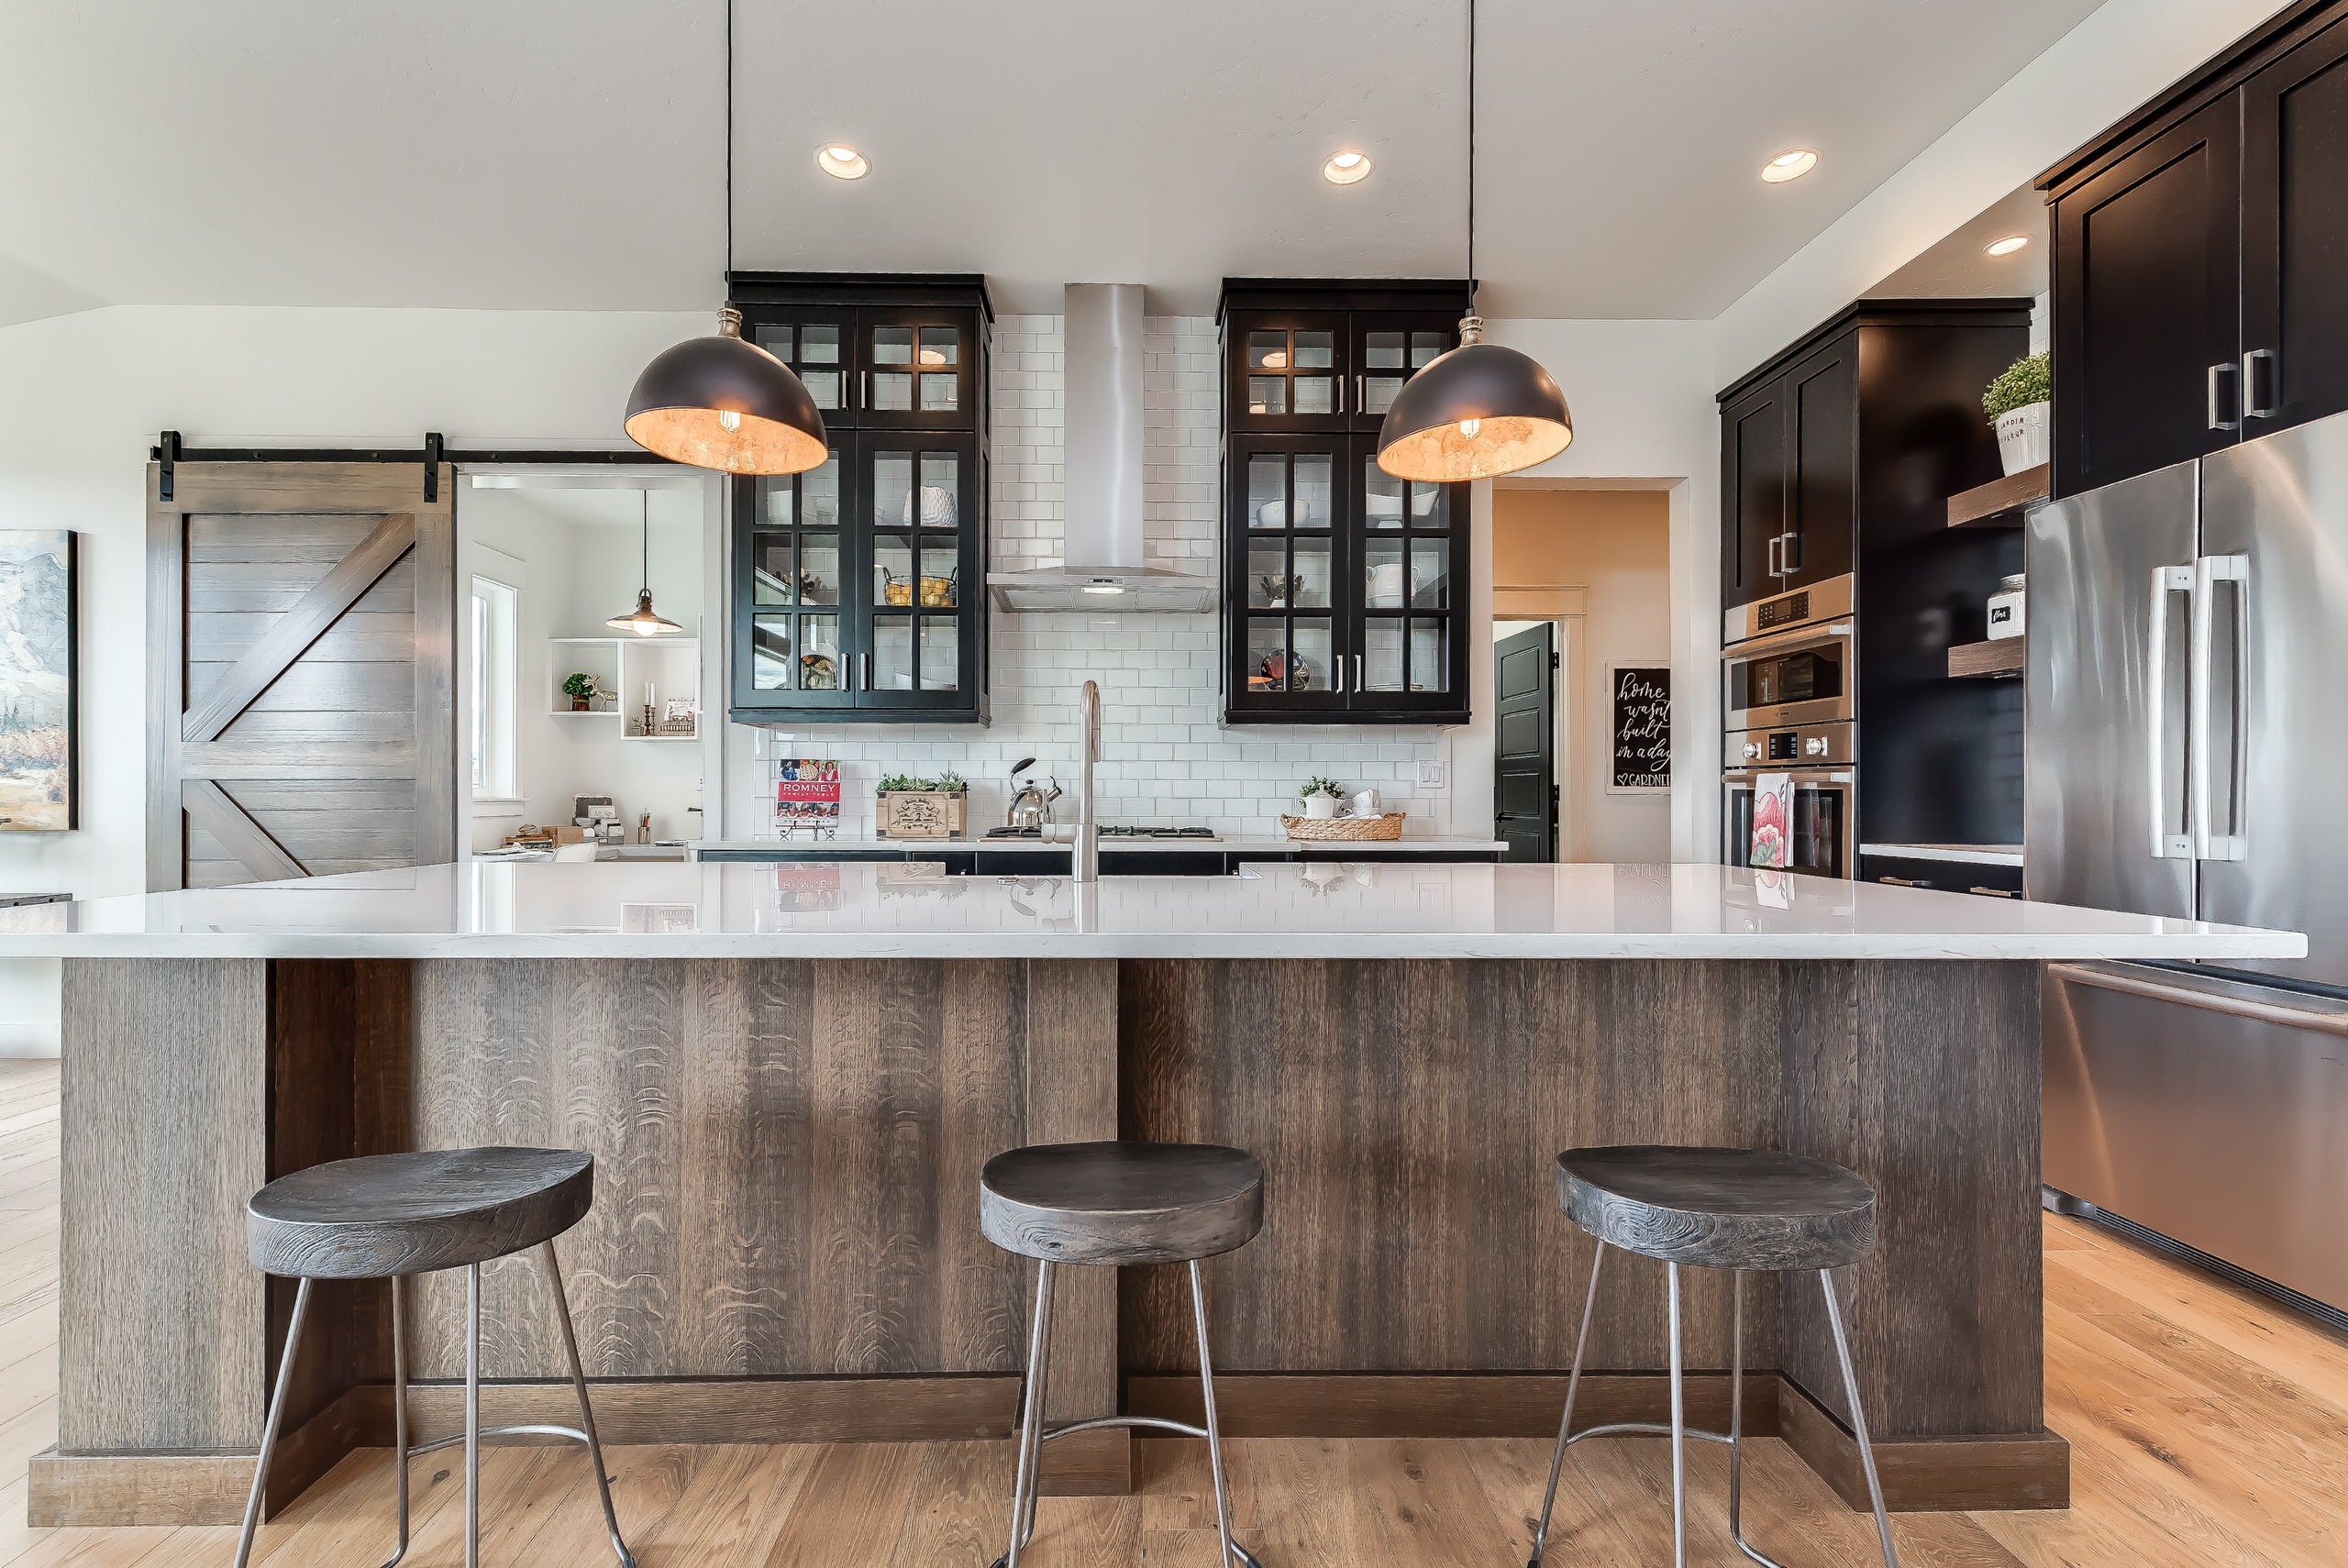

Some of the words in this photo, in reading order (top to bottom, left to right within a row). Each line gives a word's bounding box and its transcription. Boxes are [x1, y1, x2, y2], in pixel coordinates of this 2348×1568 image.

[1617, 672, 1666, 701] home
[1617, 718, 1670, 741] built
[1616, 745, 1634, 758] in
[1637, 747, 1646, 758] a
[1647, 738, 1670, 772] day
[783, 784, 836, 792] ROMNEY
